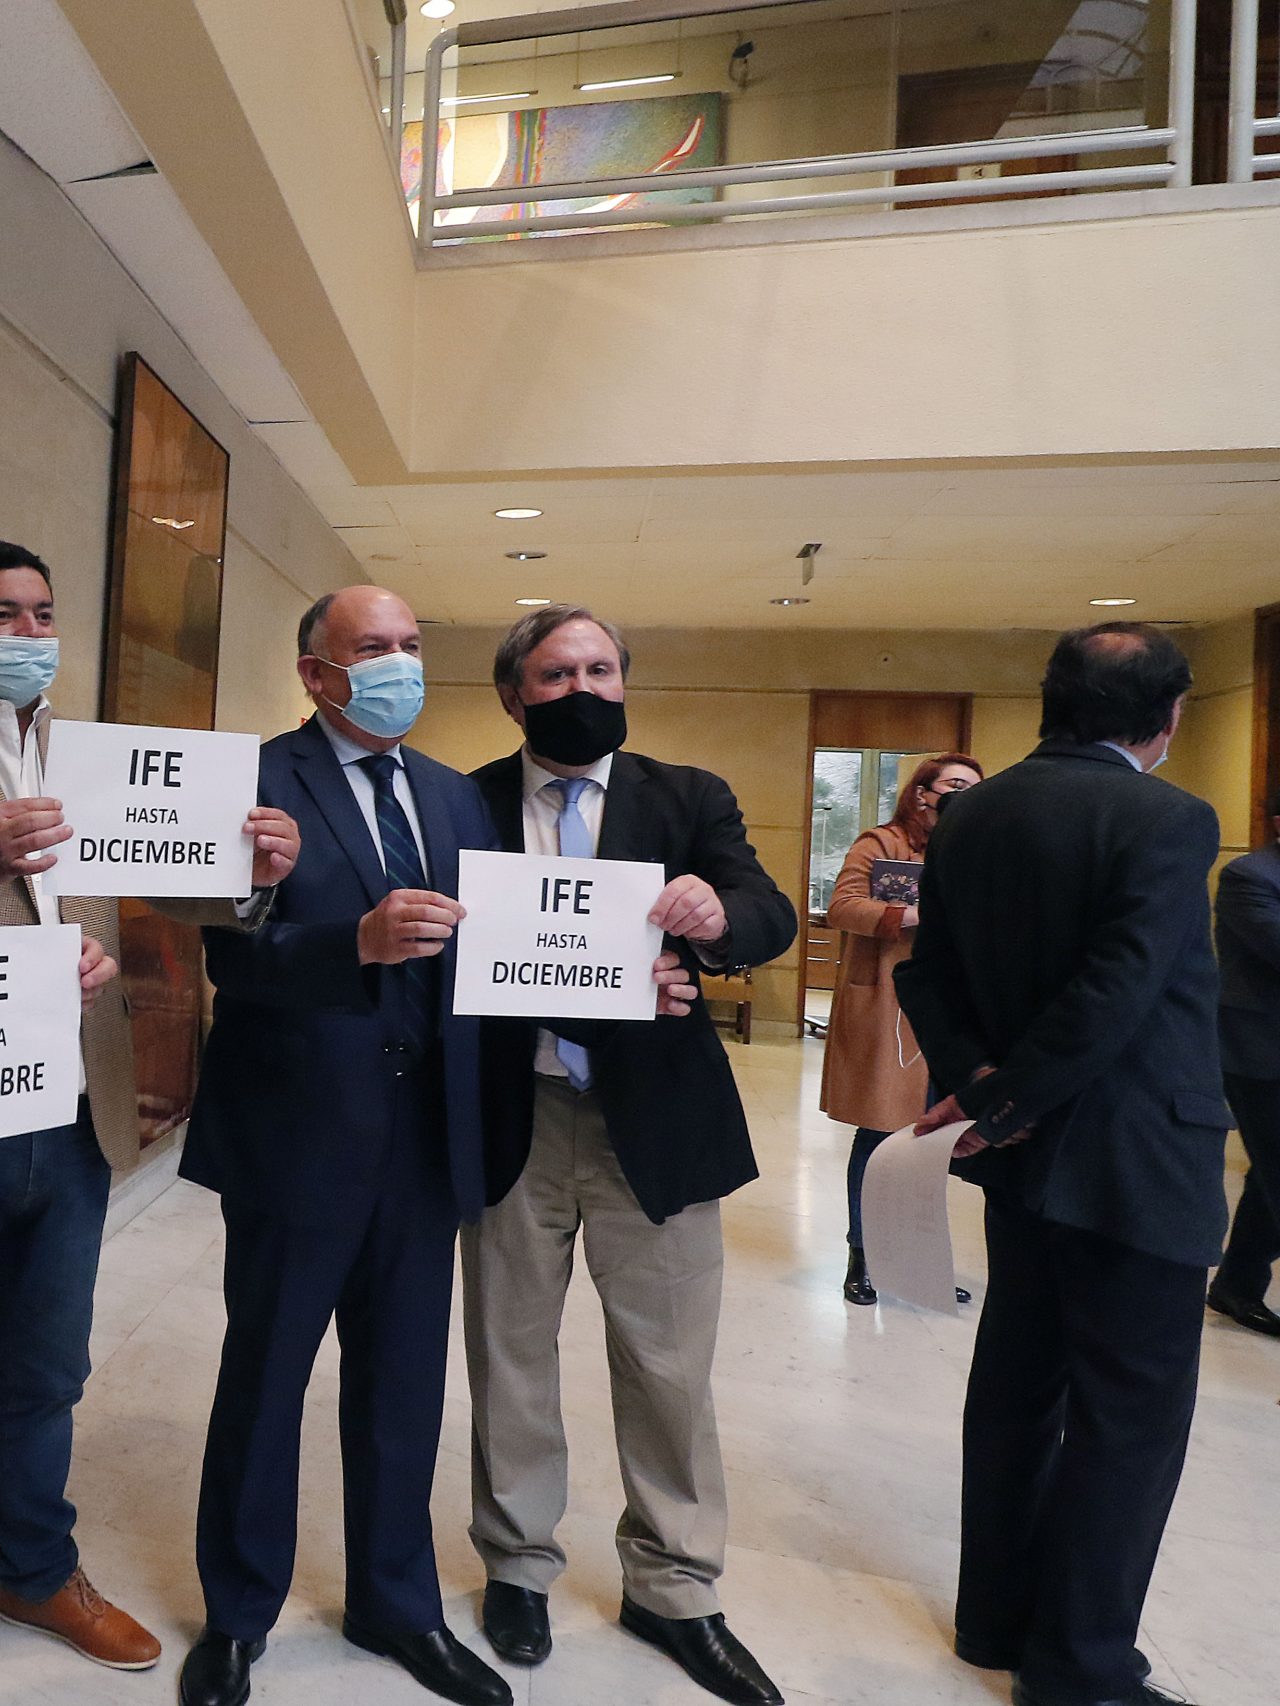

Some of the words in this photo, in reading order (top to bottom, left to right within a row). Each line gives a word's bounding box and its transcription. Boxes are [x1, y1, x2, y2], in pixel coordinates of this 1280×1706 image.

[128, 748, 183, 788] IFE
[125, 806, 179, 825] HASTA
[79, 837, 217, 865] DICIEMBRE
[540, 877, 594, 915] IFE
[536, 932, 588, 950] HASTA
[492, 961, 624, 989] DICIEMBRE
